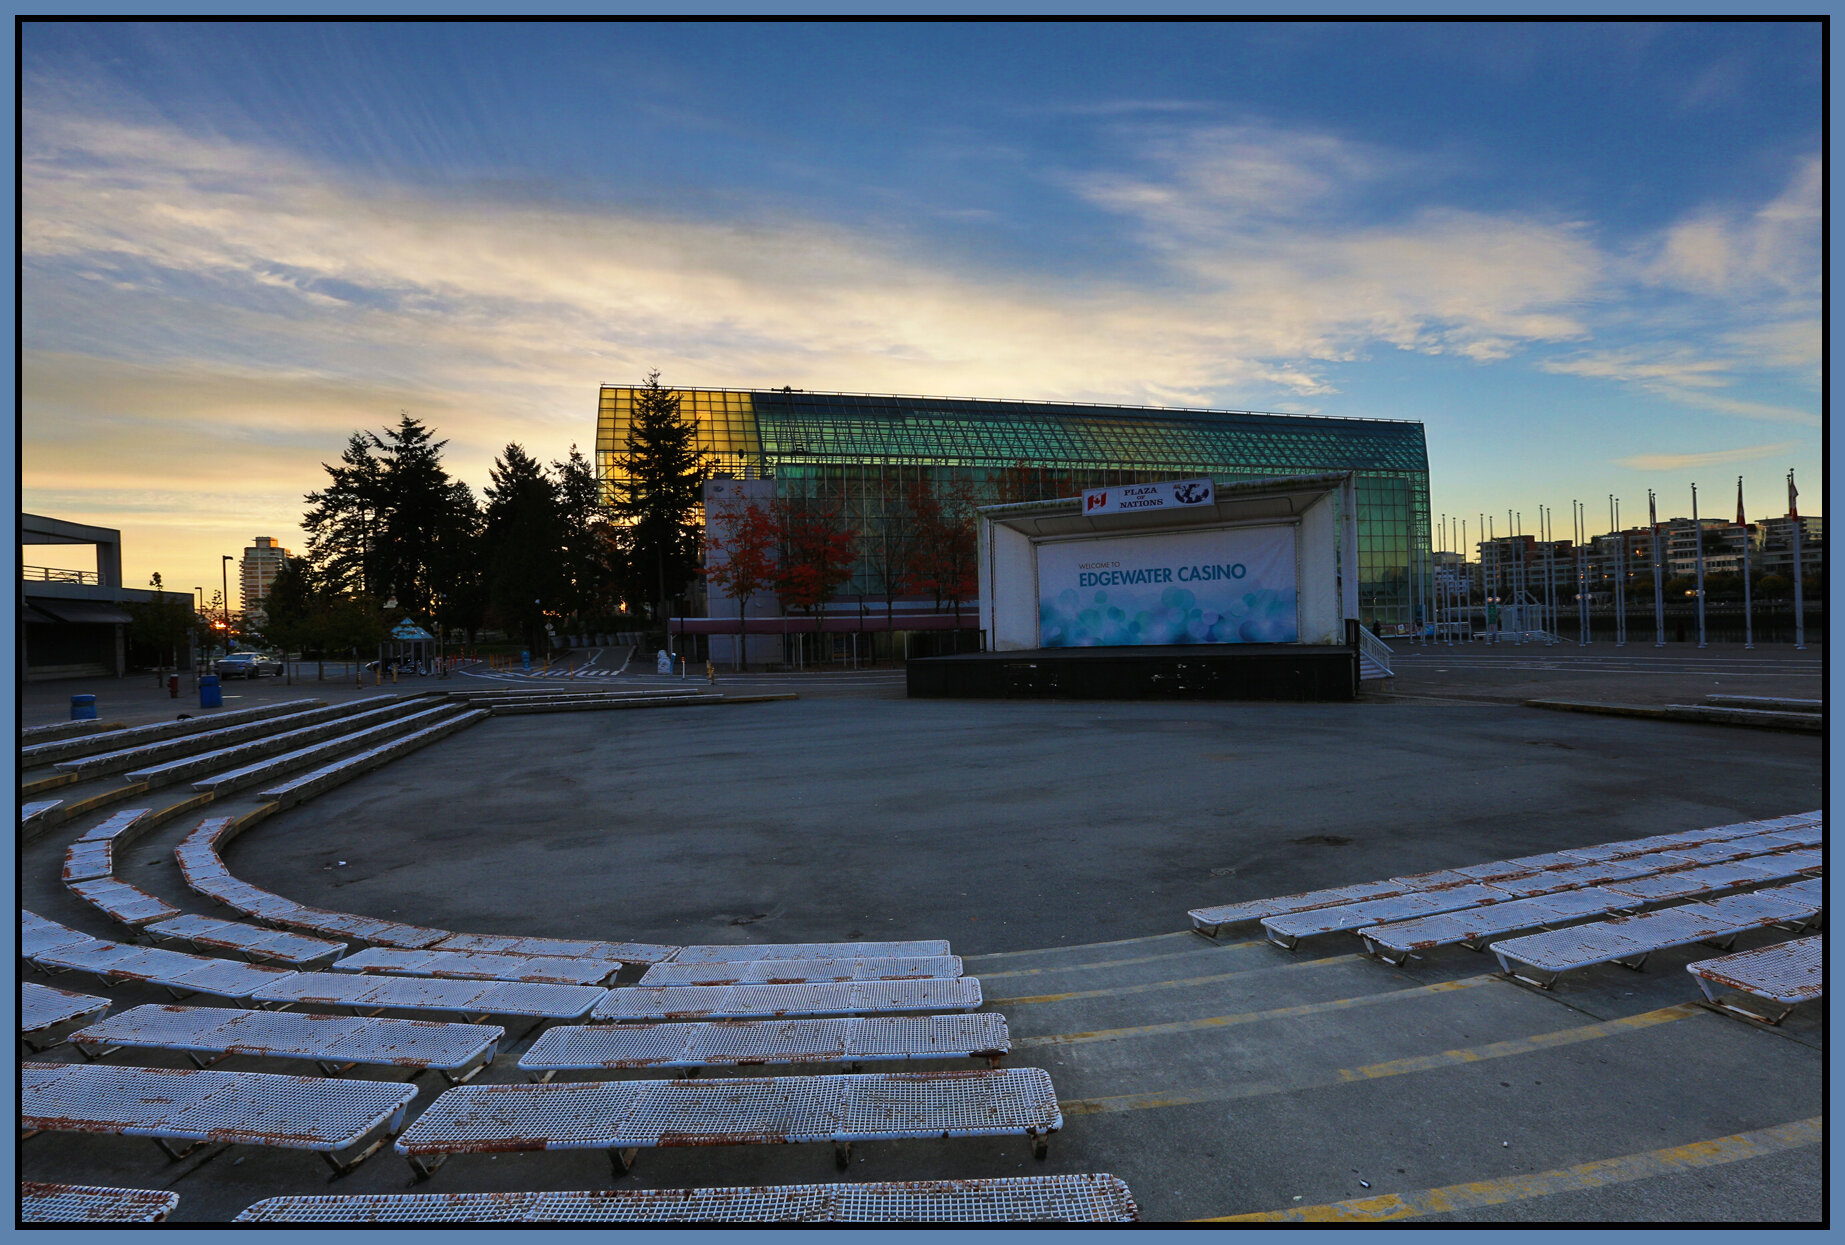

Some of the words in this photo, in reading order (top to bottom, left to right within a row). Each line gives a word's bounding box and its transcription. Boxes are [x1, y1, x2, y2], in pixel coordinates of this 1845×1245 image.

[1124, 487, 1157, 496] PLAZA
[1120, 499, 1164, 508] NATIONS
[1079, 562, 1109, 570] WELCOME
[1079, 568, 1173, 587] EDGEWATER
[1178, 563, 1247, 582] CASINO
